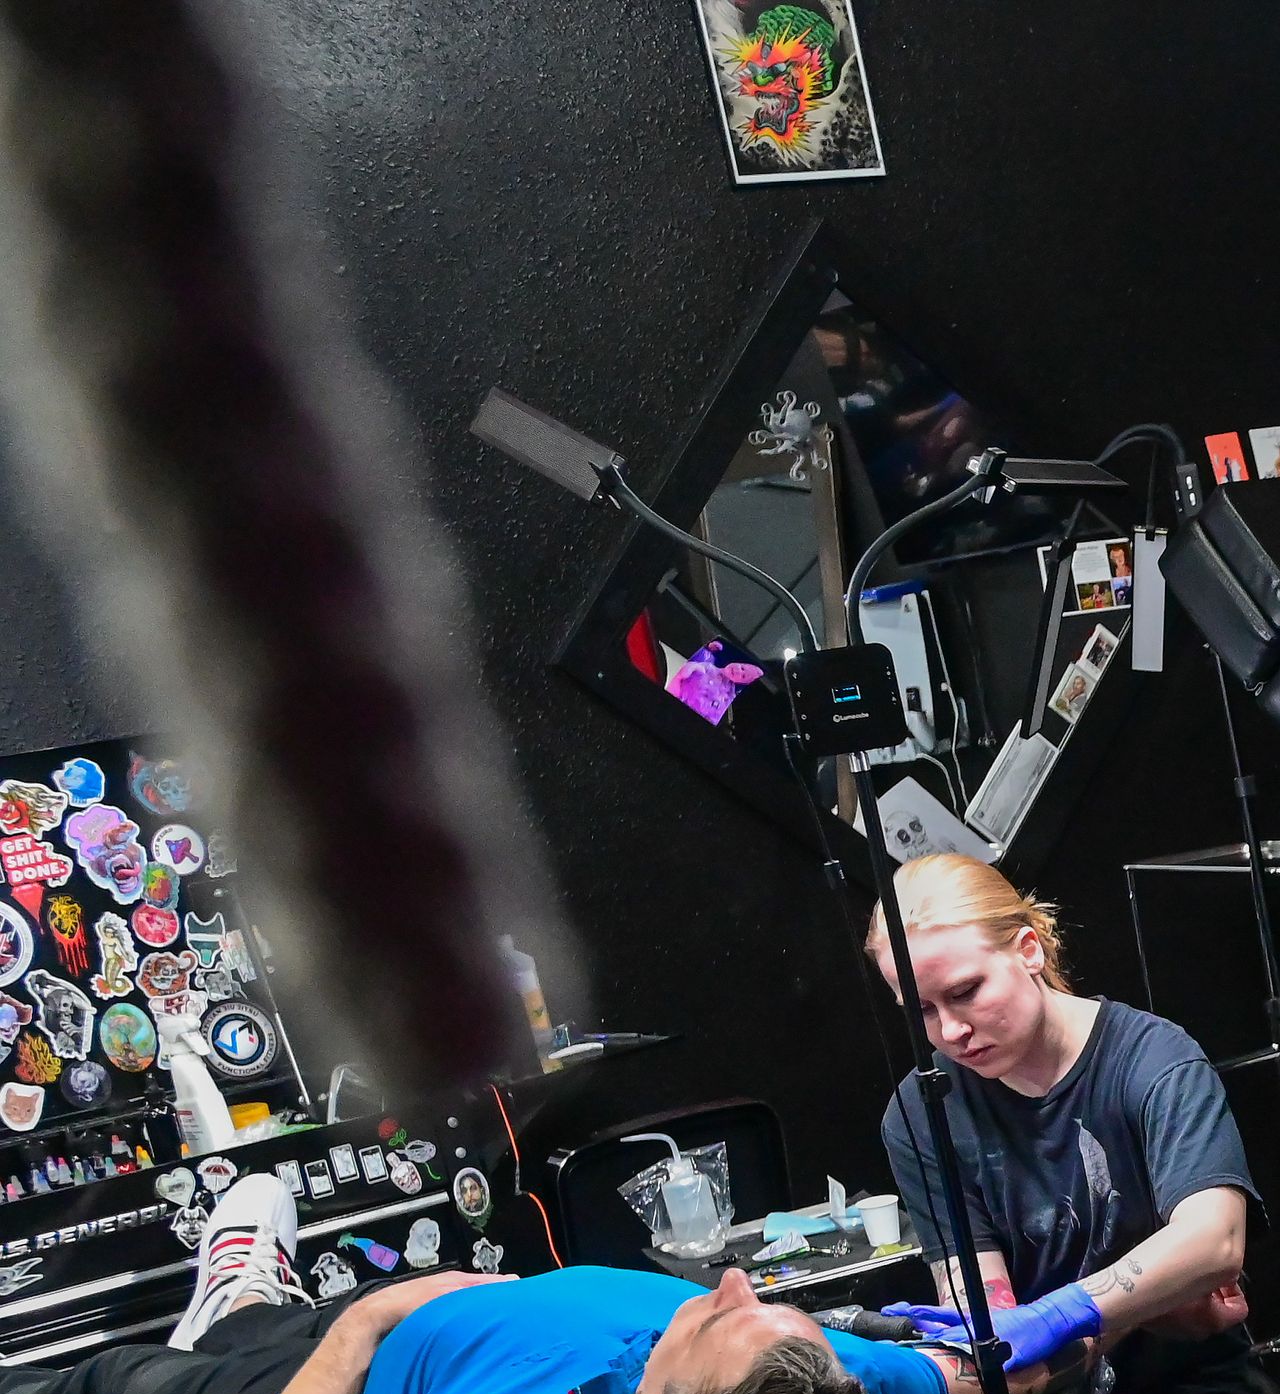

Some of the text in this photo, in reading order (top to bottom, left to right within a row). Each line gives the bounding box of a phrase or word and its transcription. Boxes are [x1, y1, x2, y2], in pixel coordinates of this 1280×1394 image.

[2, 838, 32, 854] GET
[6, 850, 43, 868] SHIT
[217, 1062, 266, 1076] FUNCTIONAL
